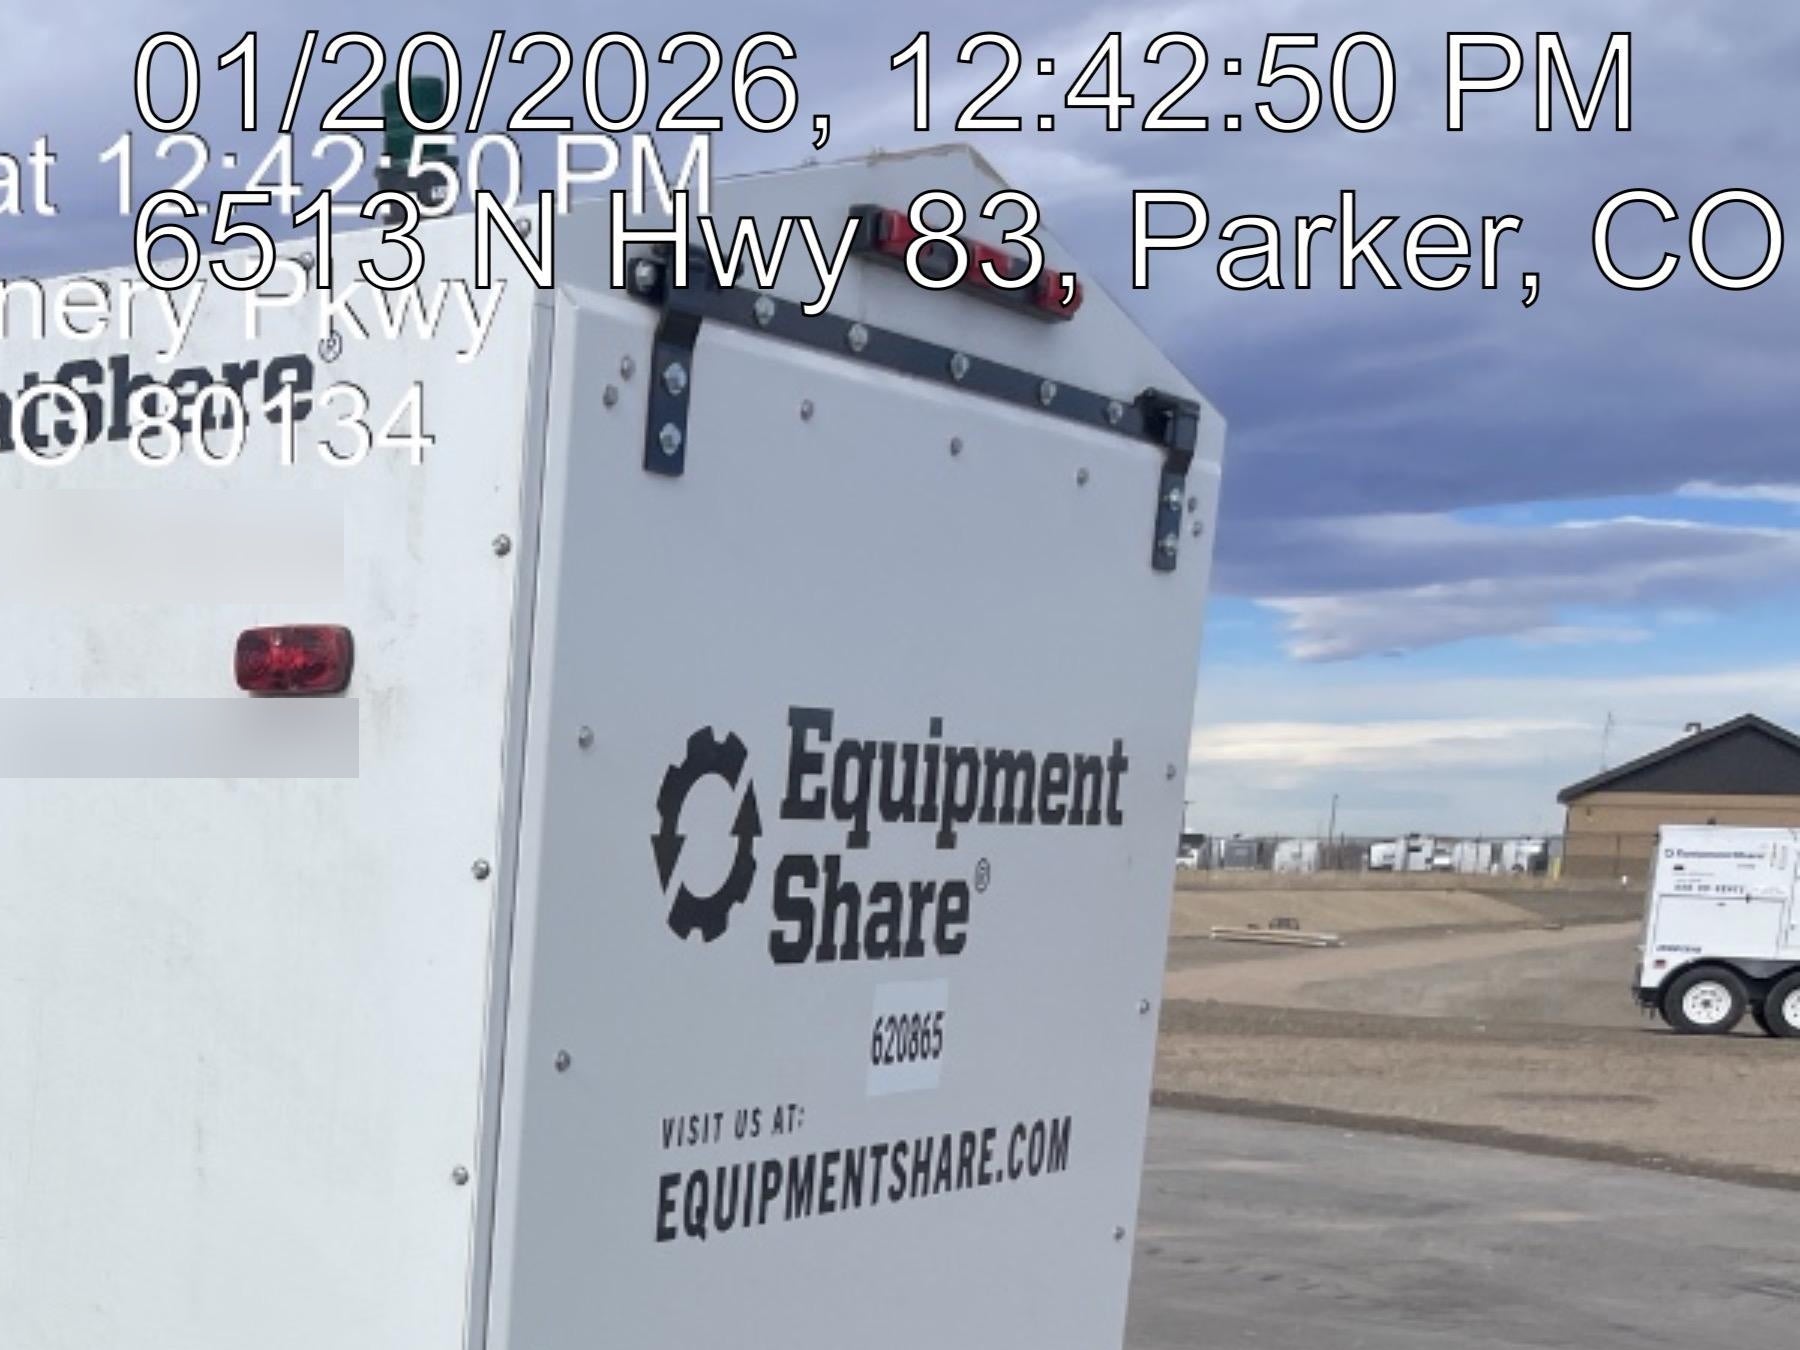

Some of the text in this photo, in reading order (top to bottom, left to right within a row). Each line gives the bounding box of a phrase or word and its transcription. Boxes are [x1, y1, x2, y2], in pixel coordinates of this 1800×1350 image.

[780, 706, 1129, 849] Equipment
[872, 1011, 945, 1066] 620865
[662, 1103, 805, 1149] VISIT US AT:
[655, 1116, 1072, 1241] EQUIPMENTSHARE.COM
